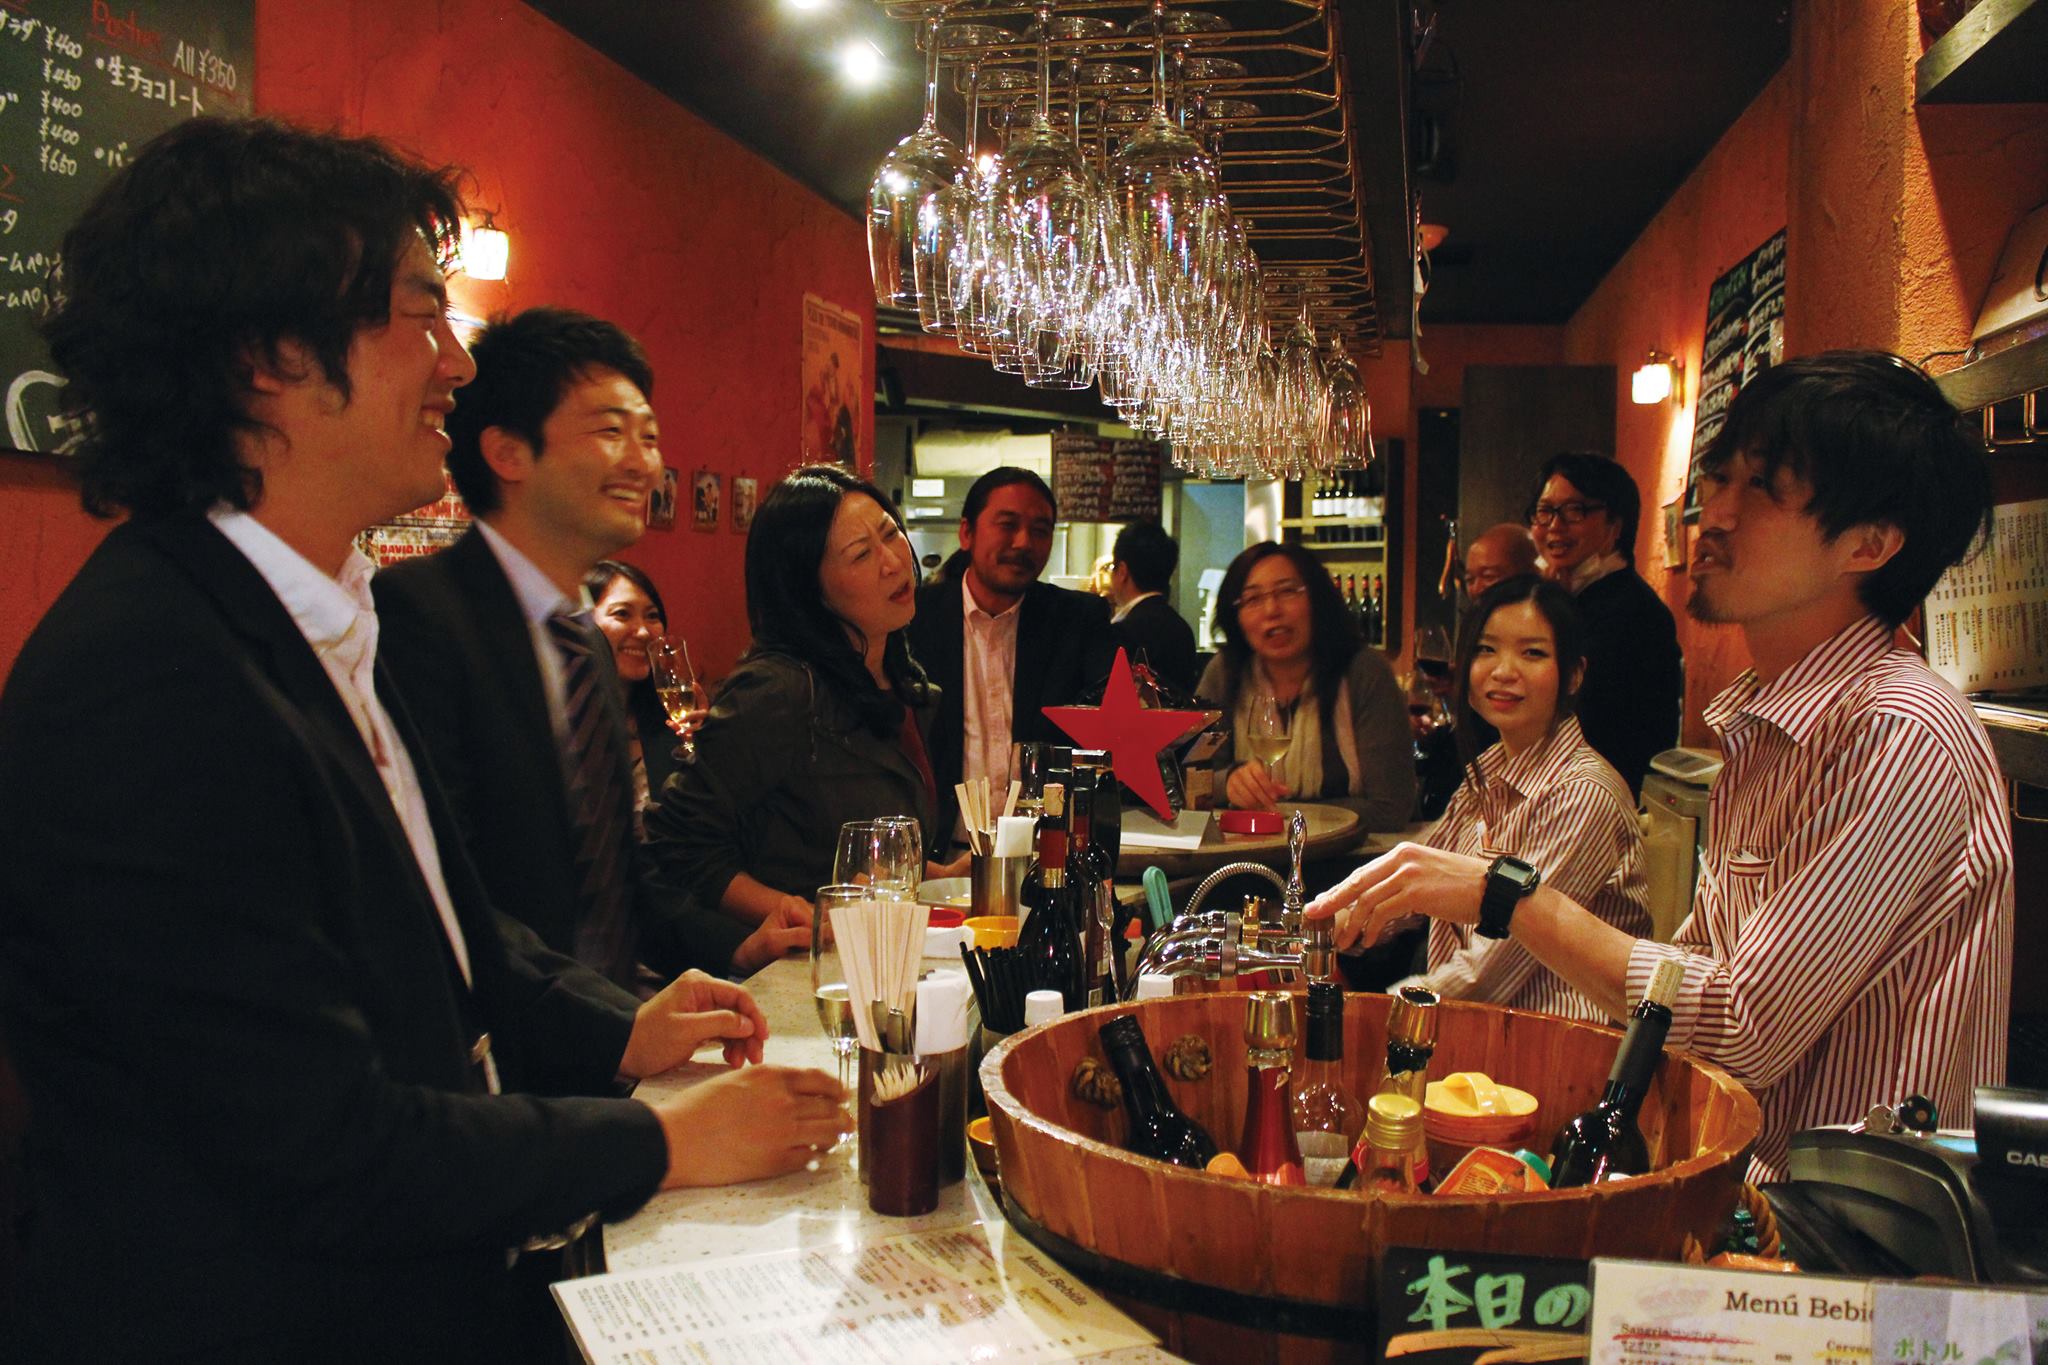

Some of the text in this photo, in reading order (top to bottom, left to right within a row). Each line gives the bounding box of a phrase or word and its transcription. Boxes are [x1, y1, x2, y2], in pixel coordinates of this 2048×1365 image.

[45, 26, 83, 59] ¥400
[43, 58, 81, 91] ¥450
[173, 40, 236, 91] All ¥350
[41, 89, 82, 117] ¥400
[39, 116, 80, 145] ¥400
[40, 144, 77, 176] ¥650
[380, 544, 413, 554] DAVID
[1406, 1255, 1591, 1331] 本日の
[1725, 1291, 1799, 1316] Menú
